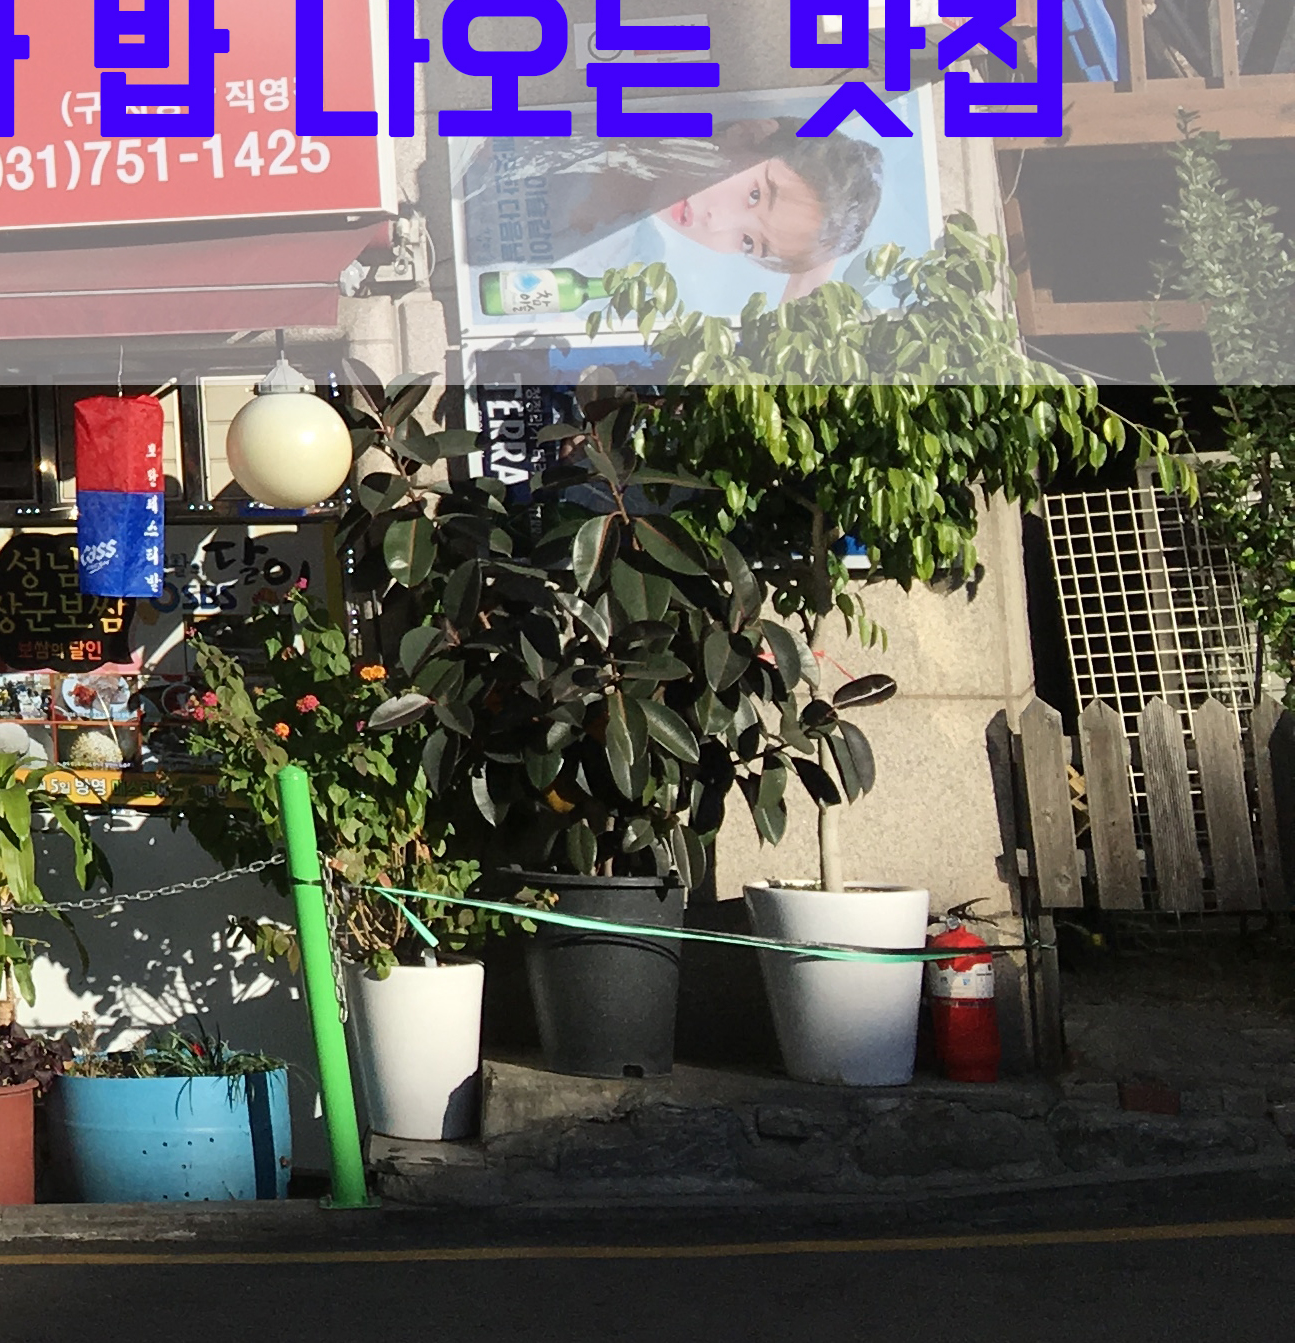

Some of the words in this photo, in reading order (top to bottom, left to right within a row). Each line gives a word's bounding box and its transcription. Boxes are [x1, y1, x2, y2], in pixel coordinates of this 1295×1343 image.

[225, 74, 297, 114] 직영
[483, 372, 530, 486] TERRA
[68, 640, 103, 661] 달인
